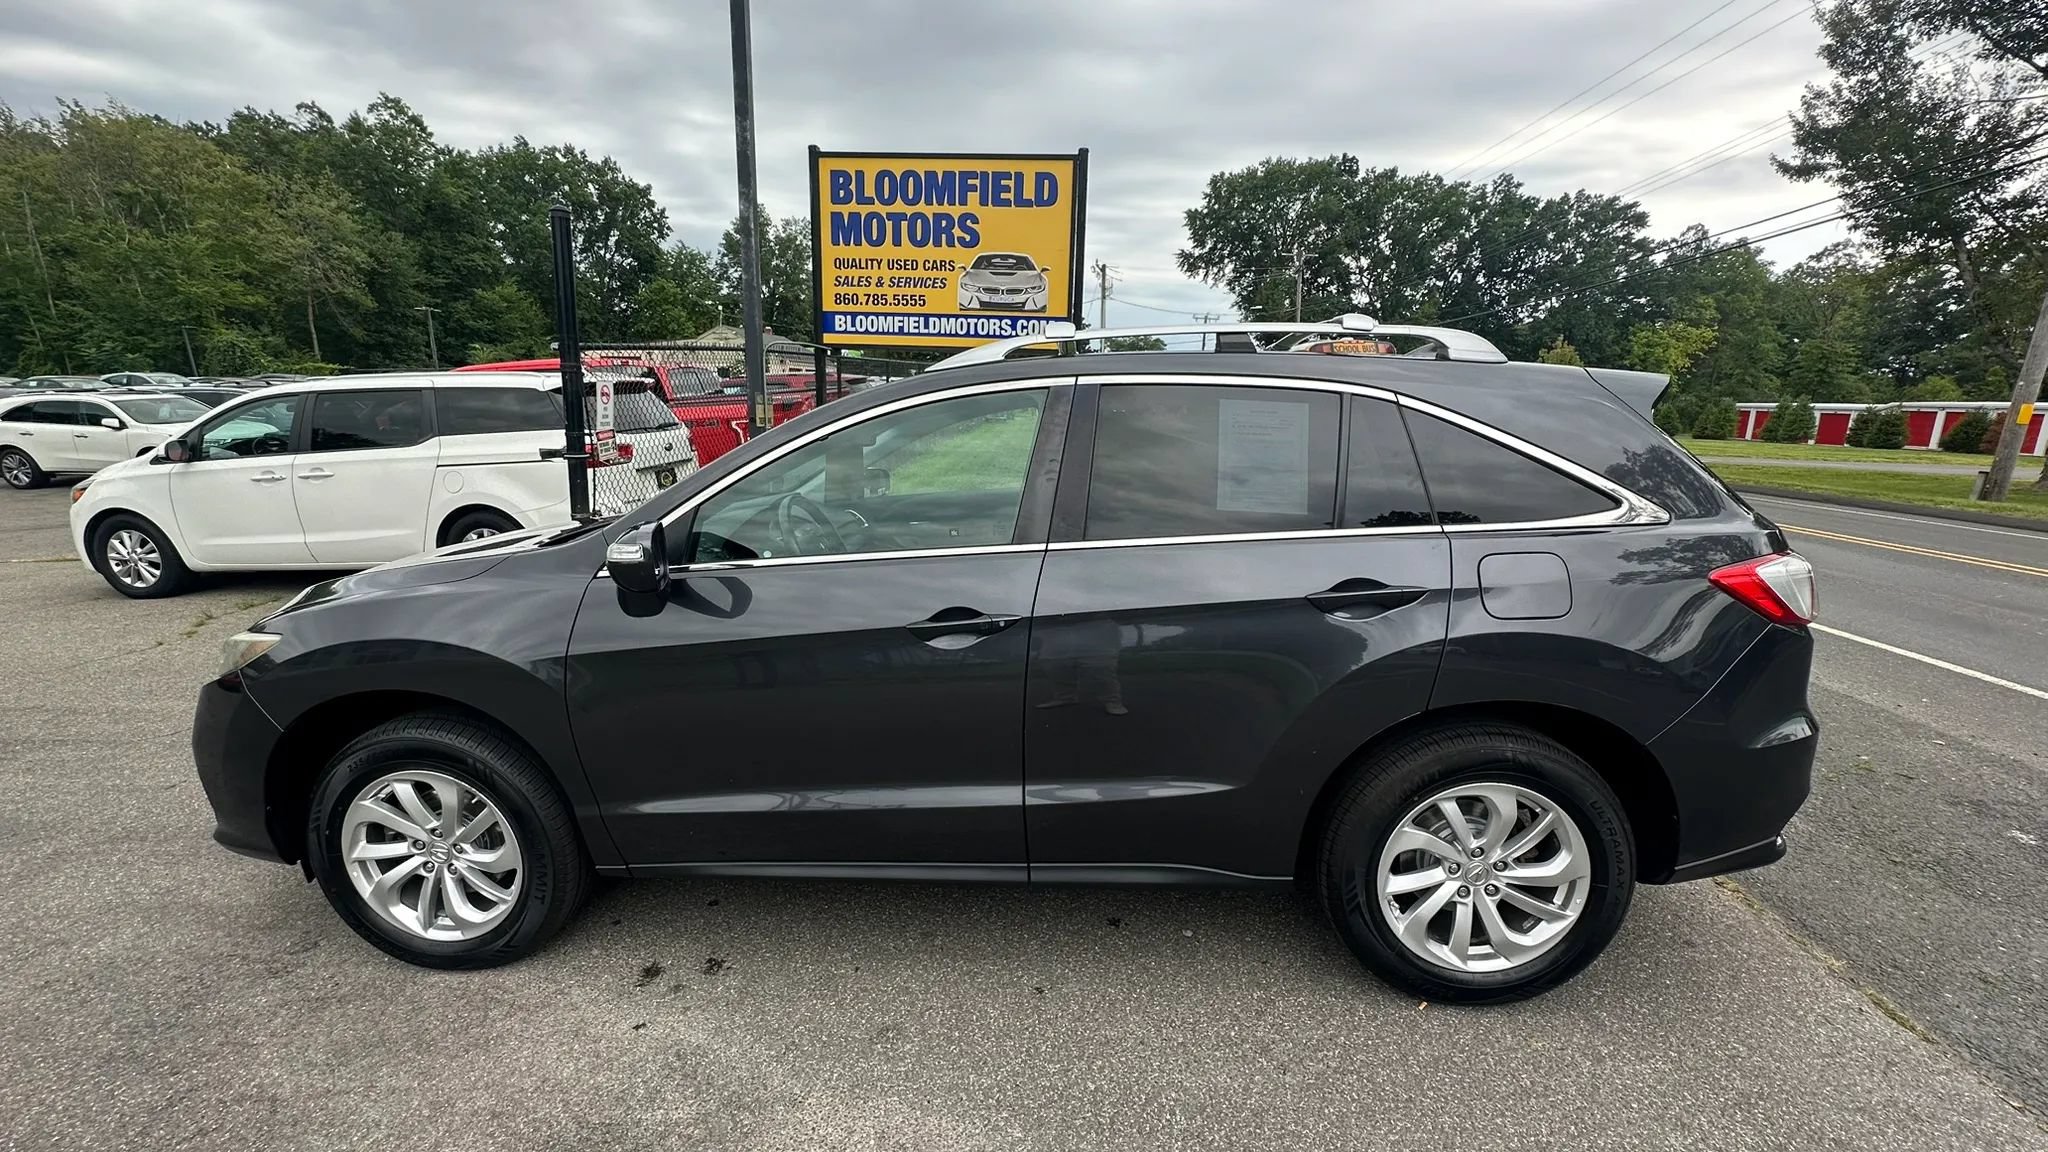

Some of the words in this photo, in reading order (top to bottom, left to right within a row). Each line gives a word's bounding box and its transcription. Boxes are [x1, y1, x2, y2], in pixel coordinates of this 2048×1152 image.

[829, 169, 1058, 208] BLOOMFIELD
[830, 211, 981, 248] MOTORS
[834, 257, 883, 271] QUALITY
[887, 259, 919, 271] USED
[923, 260, 956, 272] CARS
[834, 275, 872, 288] SALES
[875, 276, 884, 288] &
[888, 276, 948, 289] SERVICES
[834, 293, 926, 307] 860.785.5555
[1334, 343, 1360, 353] SCHOOL
[1362, 344, 1376, 353] BUS
[1590, 800, 1626, 890] ULTRAMAX
